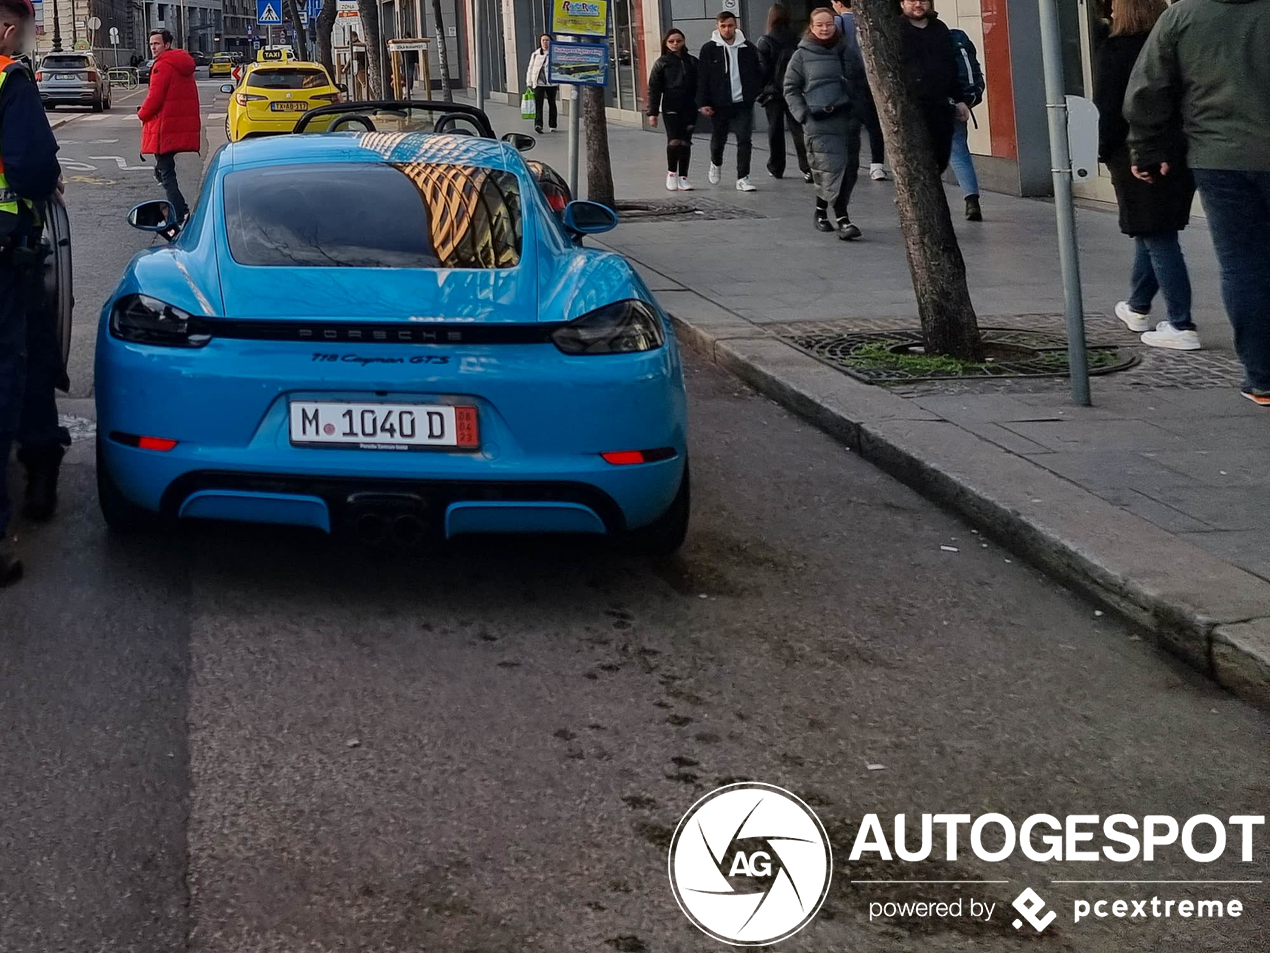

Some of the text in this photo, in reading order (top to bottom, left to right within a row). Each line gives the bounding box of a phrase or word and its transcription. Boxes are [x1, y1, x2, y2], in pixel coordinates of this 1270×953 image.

[298, 328, 462, 341] PORSCHE
[311, 353, 451, 366] 718 Cayman GTS
[301, 407, 446, 440] M 1040 D
